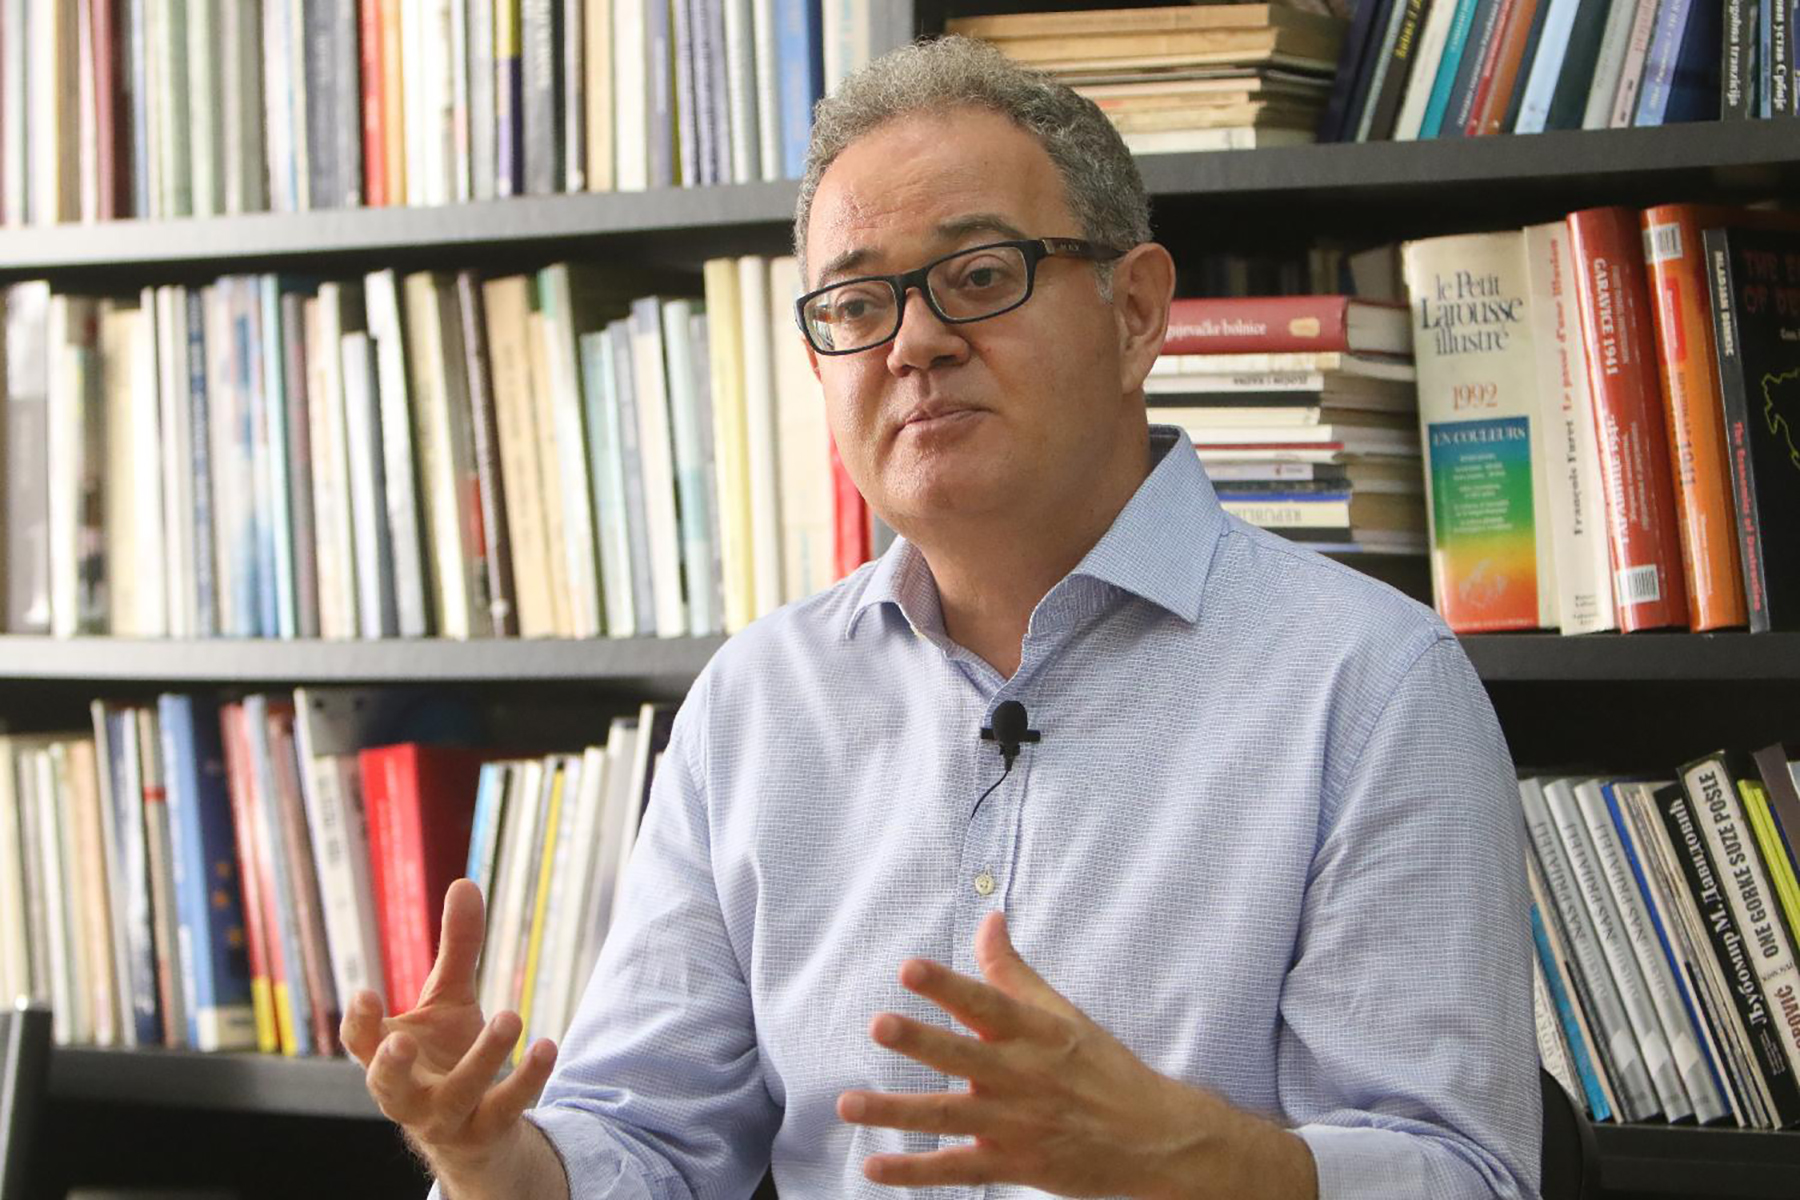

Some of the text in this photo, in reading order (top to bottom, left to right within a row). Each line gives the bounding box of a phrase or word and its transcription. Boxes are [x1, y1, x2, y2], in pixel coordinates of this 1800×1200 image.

[1773, 63, 1788, 111] Србије
[1436, 270, 1502, 301] le Petit
[1222, 318, 1267, 336] bolnice
[1421, 297, 1524, 329] Larousse
[1593, 257, 1620, 375] GARAVICE 1941
[1453, 382, 1498, 411] 1992
[1433, 426, 1526, 446] EN COULEURS
[1565, 420, 1577, 463] Furet
[1733, 421, 1744, 446] The
[1569, 466, 1583, 536] François
[1736, 448, 1751, 515] Economics
[1698, 770, 1732, 824] POSLE
[1717, 822, 1747, 867] SUZE
[1669, 797, 1768, 1026] Љубомир М. Давидовић
[1733, 865, 1767, 924] GORKE
[1754, 922, 1779, 959] ONE
